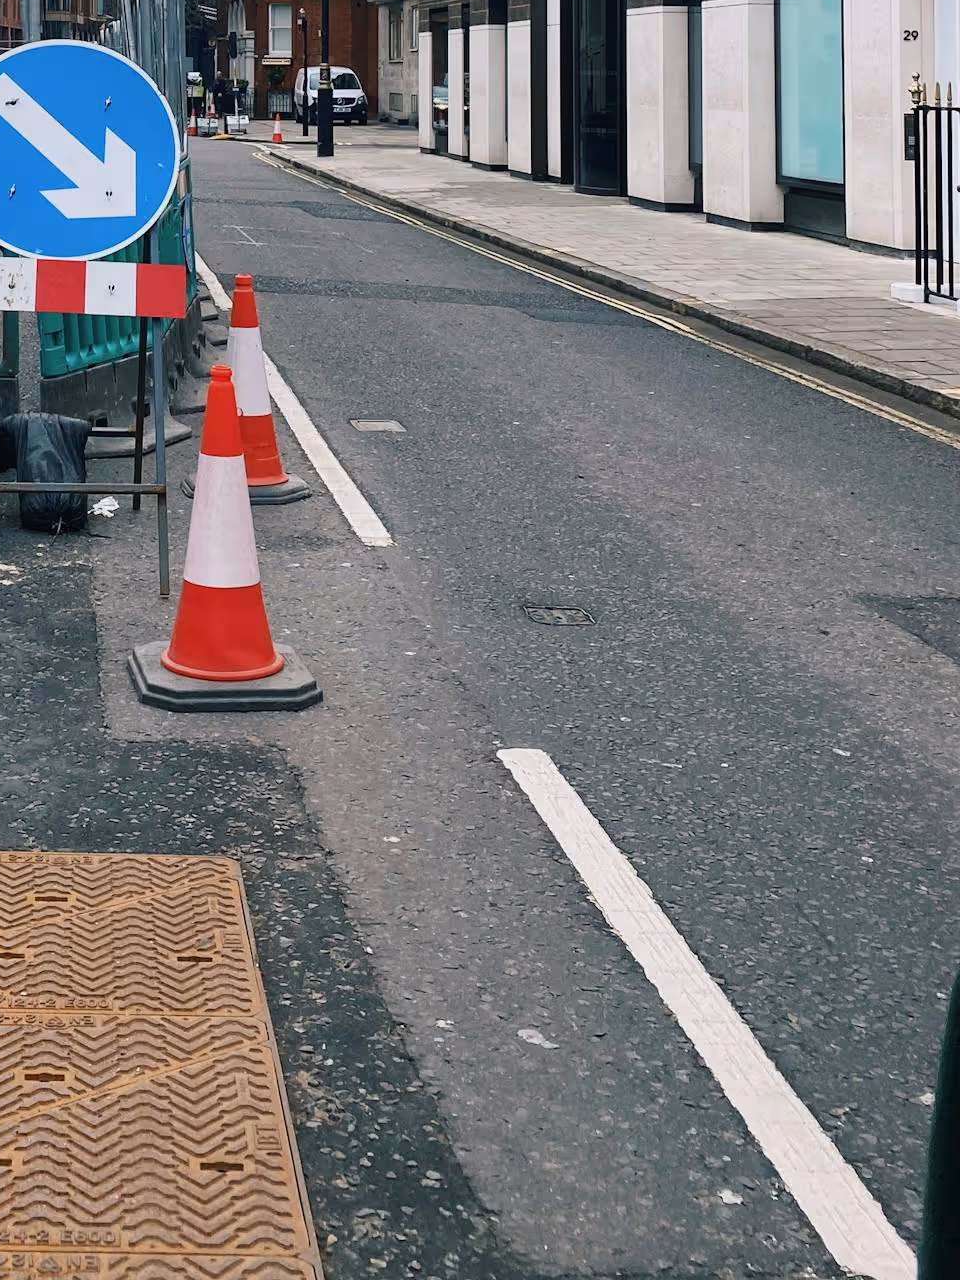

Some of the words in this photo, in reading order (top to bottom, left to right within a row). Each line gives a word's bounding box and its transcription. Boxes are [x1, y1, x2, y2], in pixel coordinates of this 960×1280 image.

[903, 30, 919, 41] 29
[64, 997, 113, 1010] E600
[59, 1229, 117, 1246] E600
